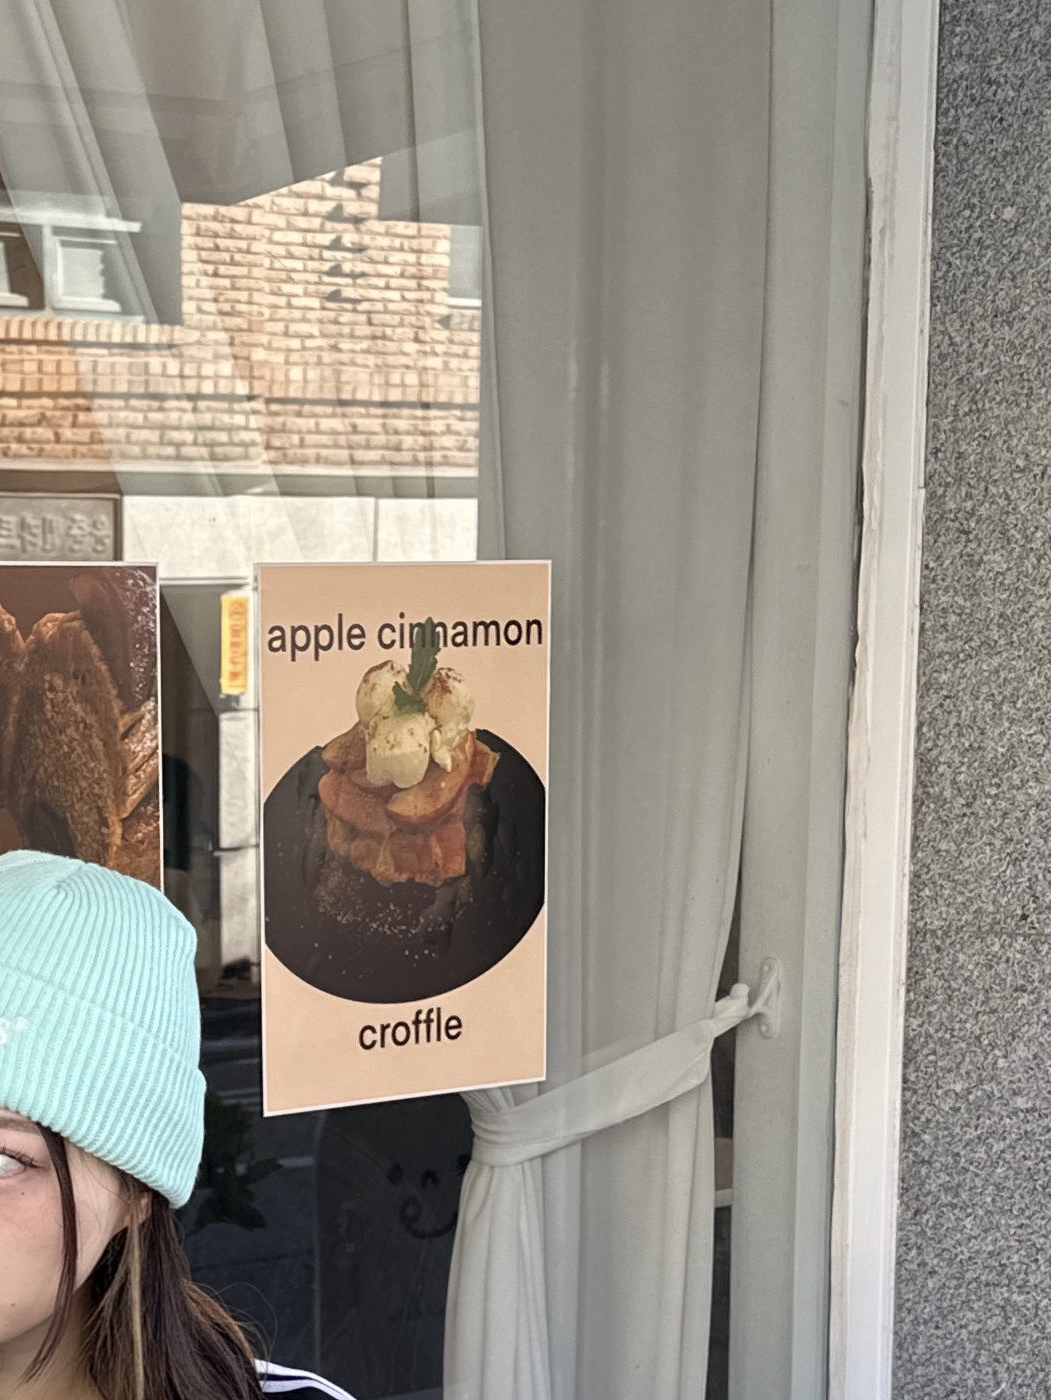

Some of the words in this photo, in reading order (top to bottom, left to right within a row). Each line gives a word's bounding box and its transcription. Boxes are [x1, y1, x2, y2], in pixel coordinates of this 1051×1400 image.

[267, 612, 367, 662] apple
[377, 611, 543, 650] cinnamon
[358, 1006, 463, 1051] croffle
